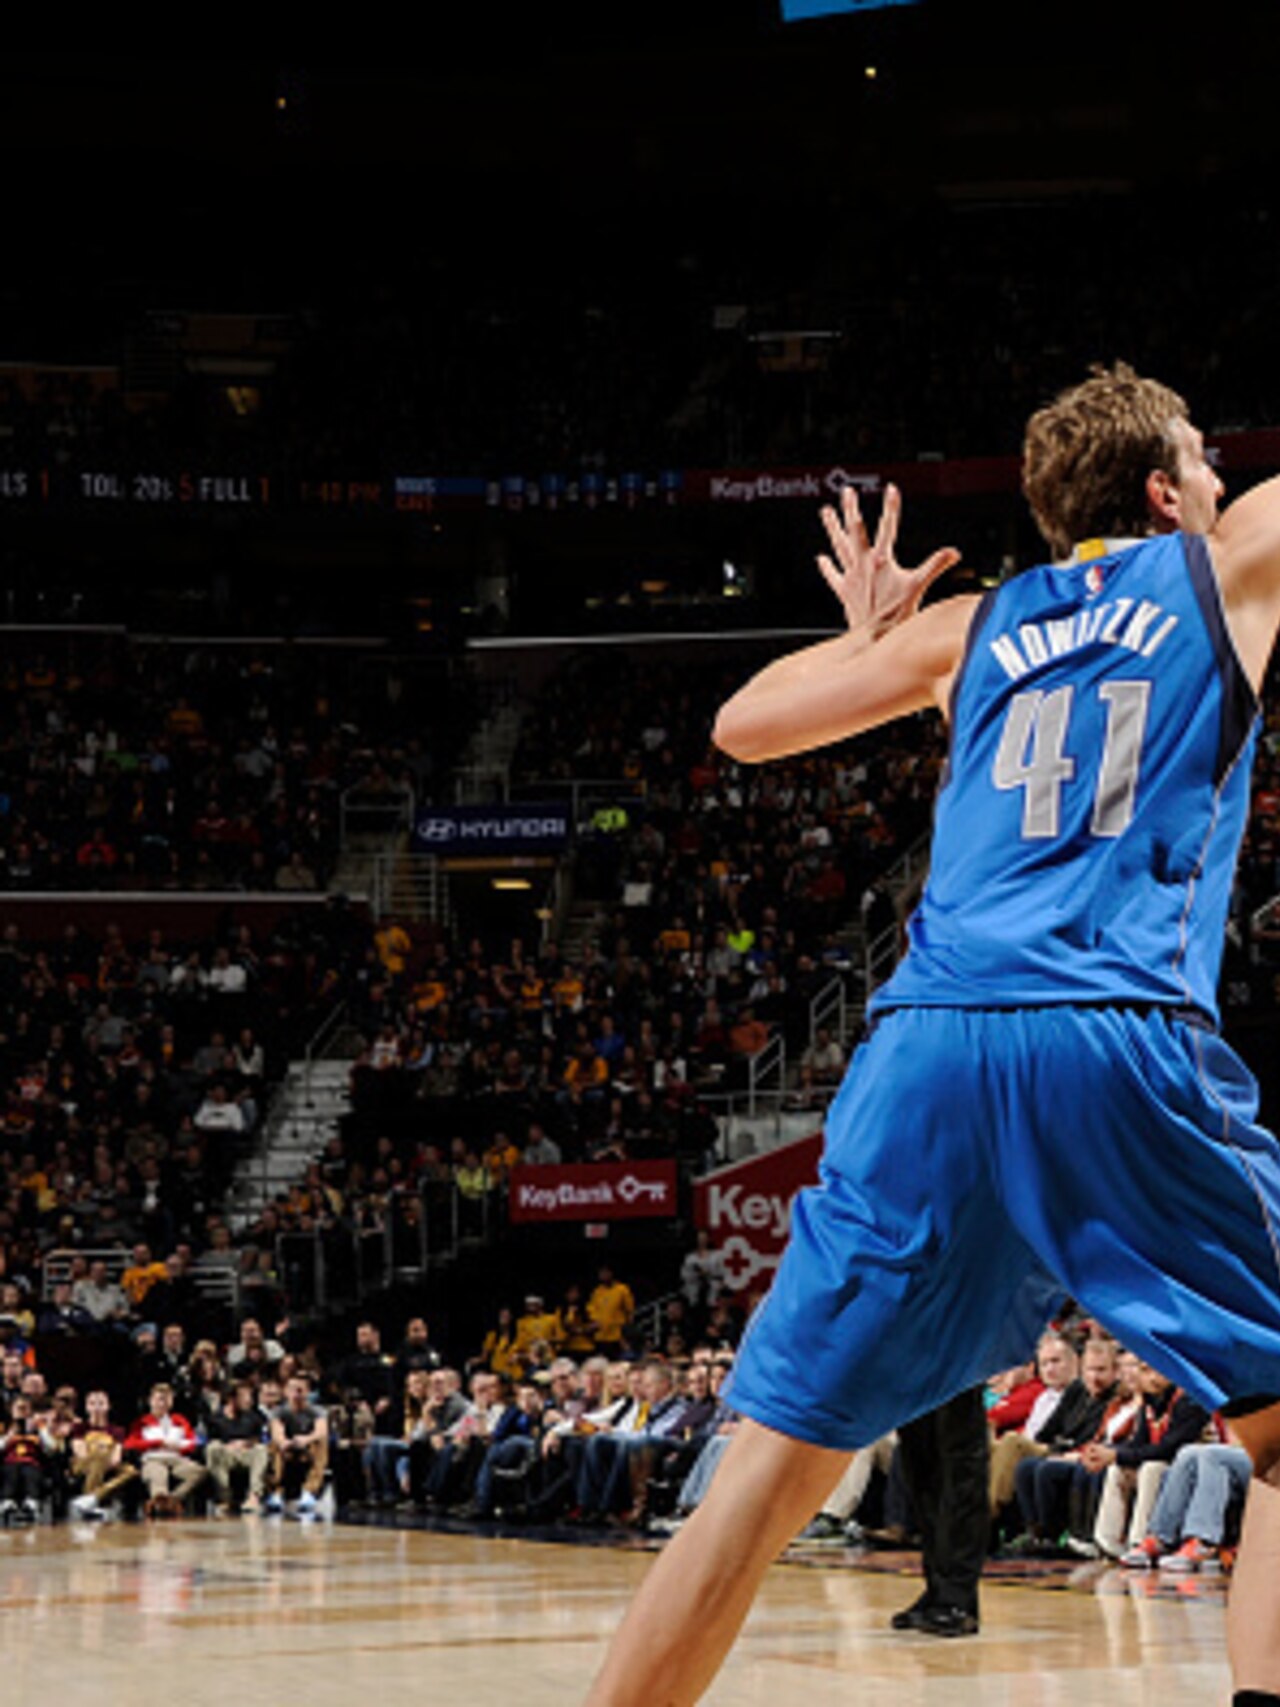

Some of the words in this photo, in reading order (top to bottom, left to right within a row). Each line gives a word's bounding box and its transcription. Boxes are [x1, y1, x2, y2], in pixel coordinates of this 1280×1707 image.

[199, 475, 252, 503] FULL
[710, 474, 821, 502] KeyBank
[992, 678, 1152, 840] 41
[459, 817, 567, 840] HYUNDAI
[517, 1180, 616, 1211] KeyBank
